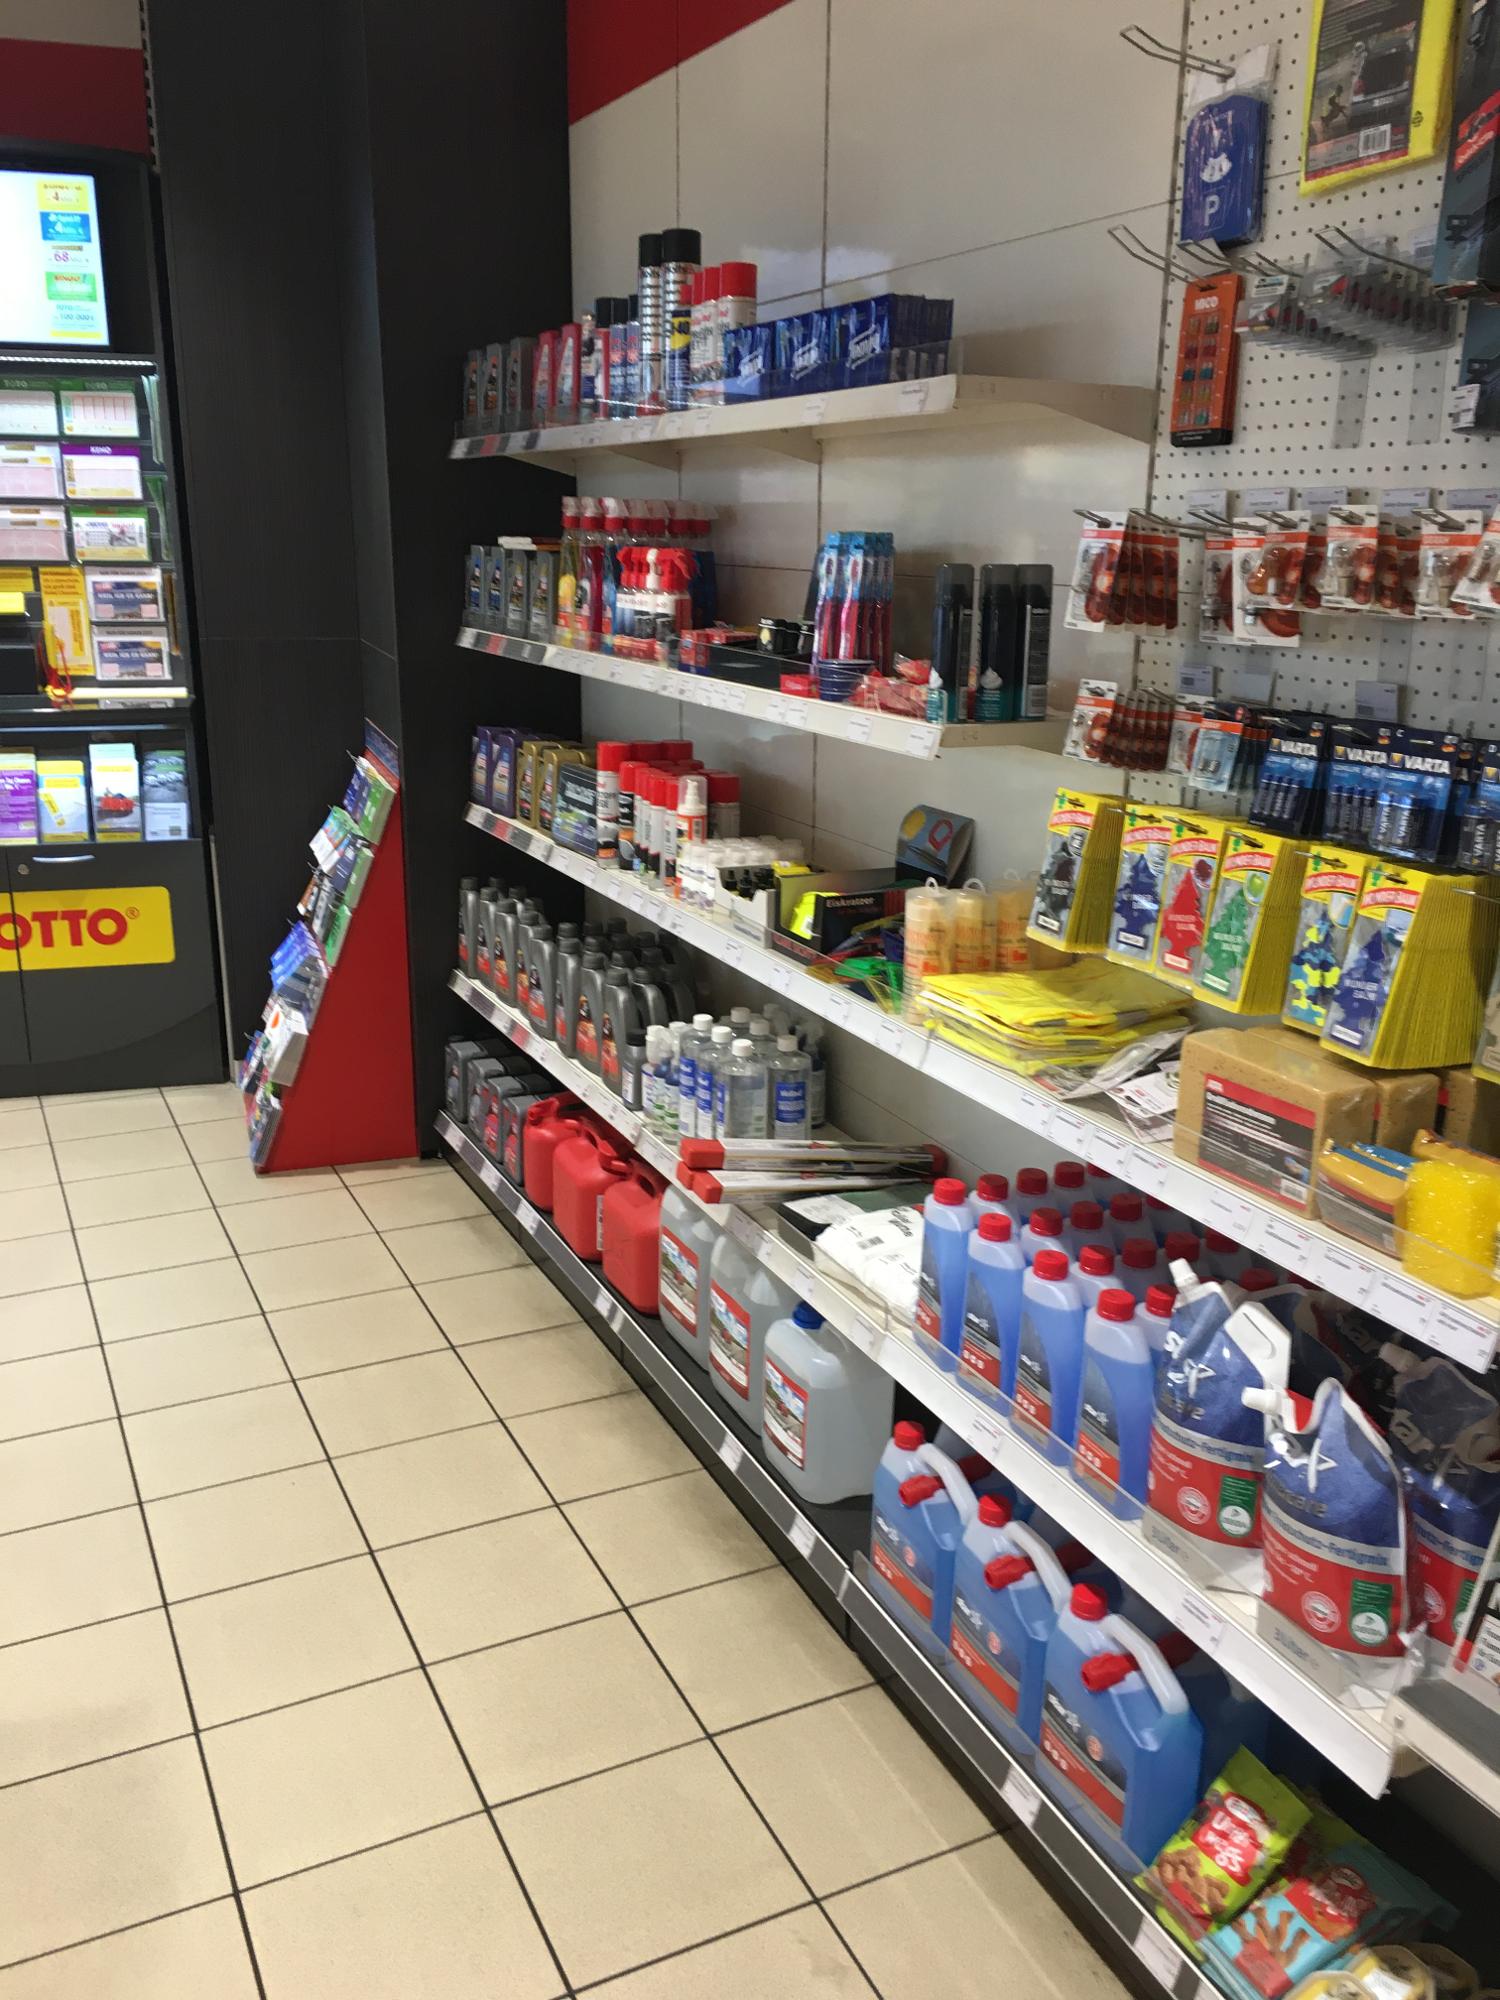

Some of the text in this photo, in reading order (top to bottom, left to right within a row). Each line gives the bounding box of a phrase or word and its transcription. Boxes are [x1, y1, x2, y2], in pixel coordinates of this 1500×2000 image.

[1280, 739, 1318, 757] VARTA
[1346, 747, 1389, 765] VARTA
[1404, 754, 1451, 775] VARTA
[1473, 823, 1487, 857] VARTA
